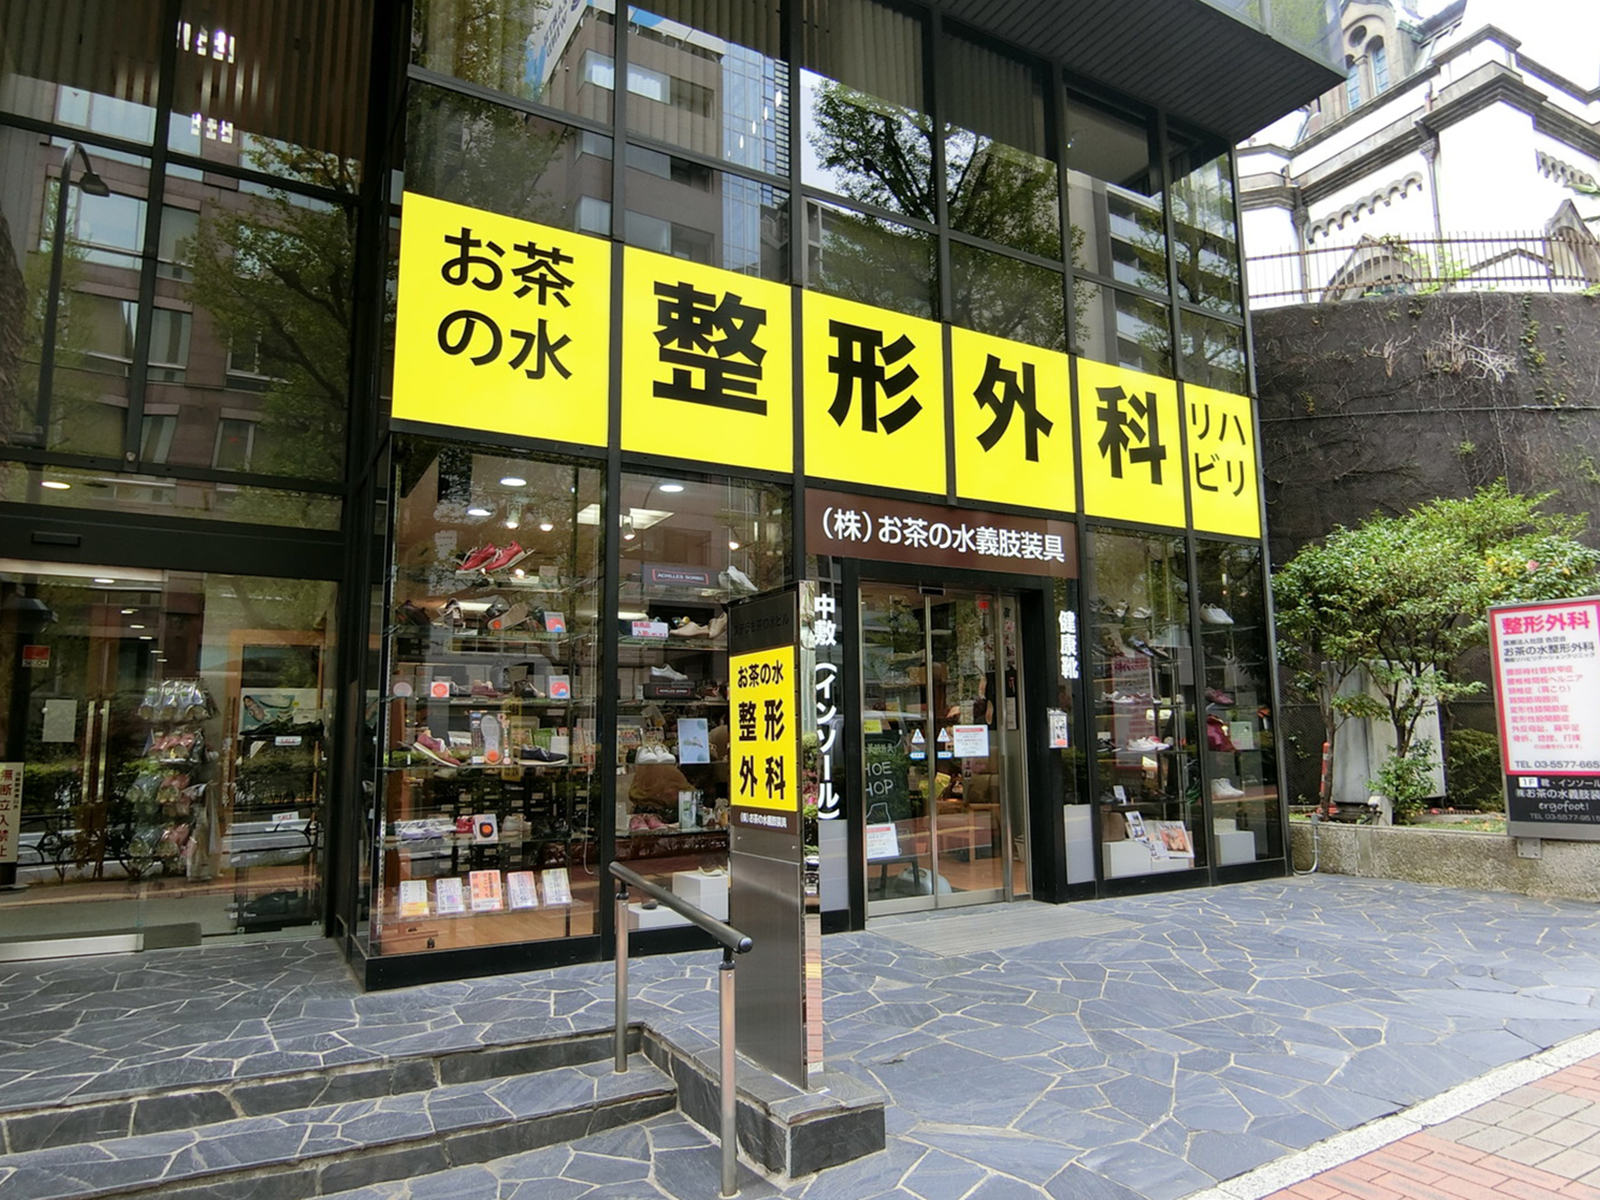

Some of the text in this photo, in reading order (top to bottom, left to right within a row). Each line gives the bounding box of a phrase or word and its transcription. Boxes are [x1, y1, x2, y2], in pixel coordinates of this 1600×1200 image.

[441, 227, 575, 308] お茶
[437, 309, 573, 380] の水
[653, 281, 1167, 485] 整形外科
[1191, 403, 1247, 447] リハ
[1194, 454, 1245, 497] ビリ
[1501, 611, 1590, 635] 整形外科
[737, 659, 784, 688] お茶の水
[738, 698, 785, 742] 整形
[738, 755, 786, 801] 外科
[866, 761, 893, 777] HOE
[1515, 760, 1600, 769] TEL 03-5577-665
[866, 779, 894, 797] HOP
